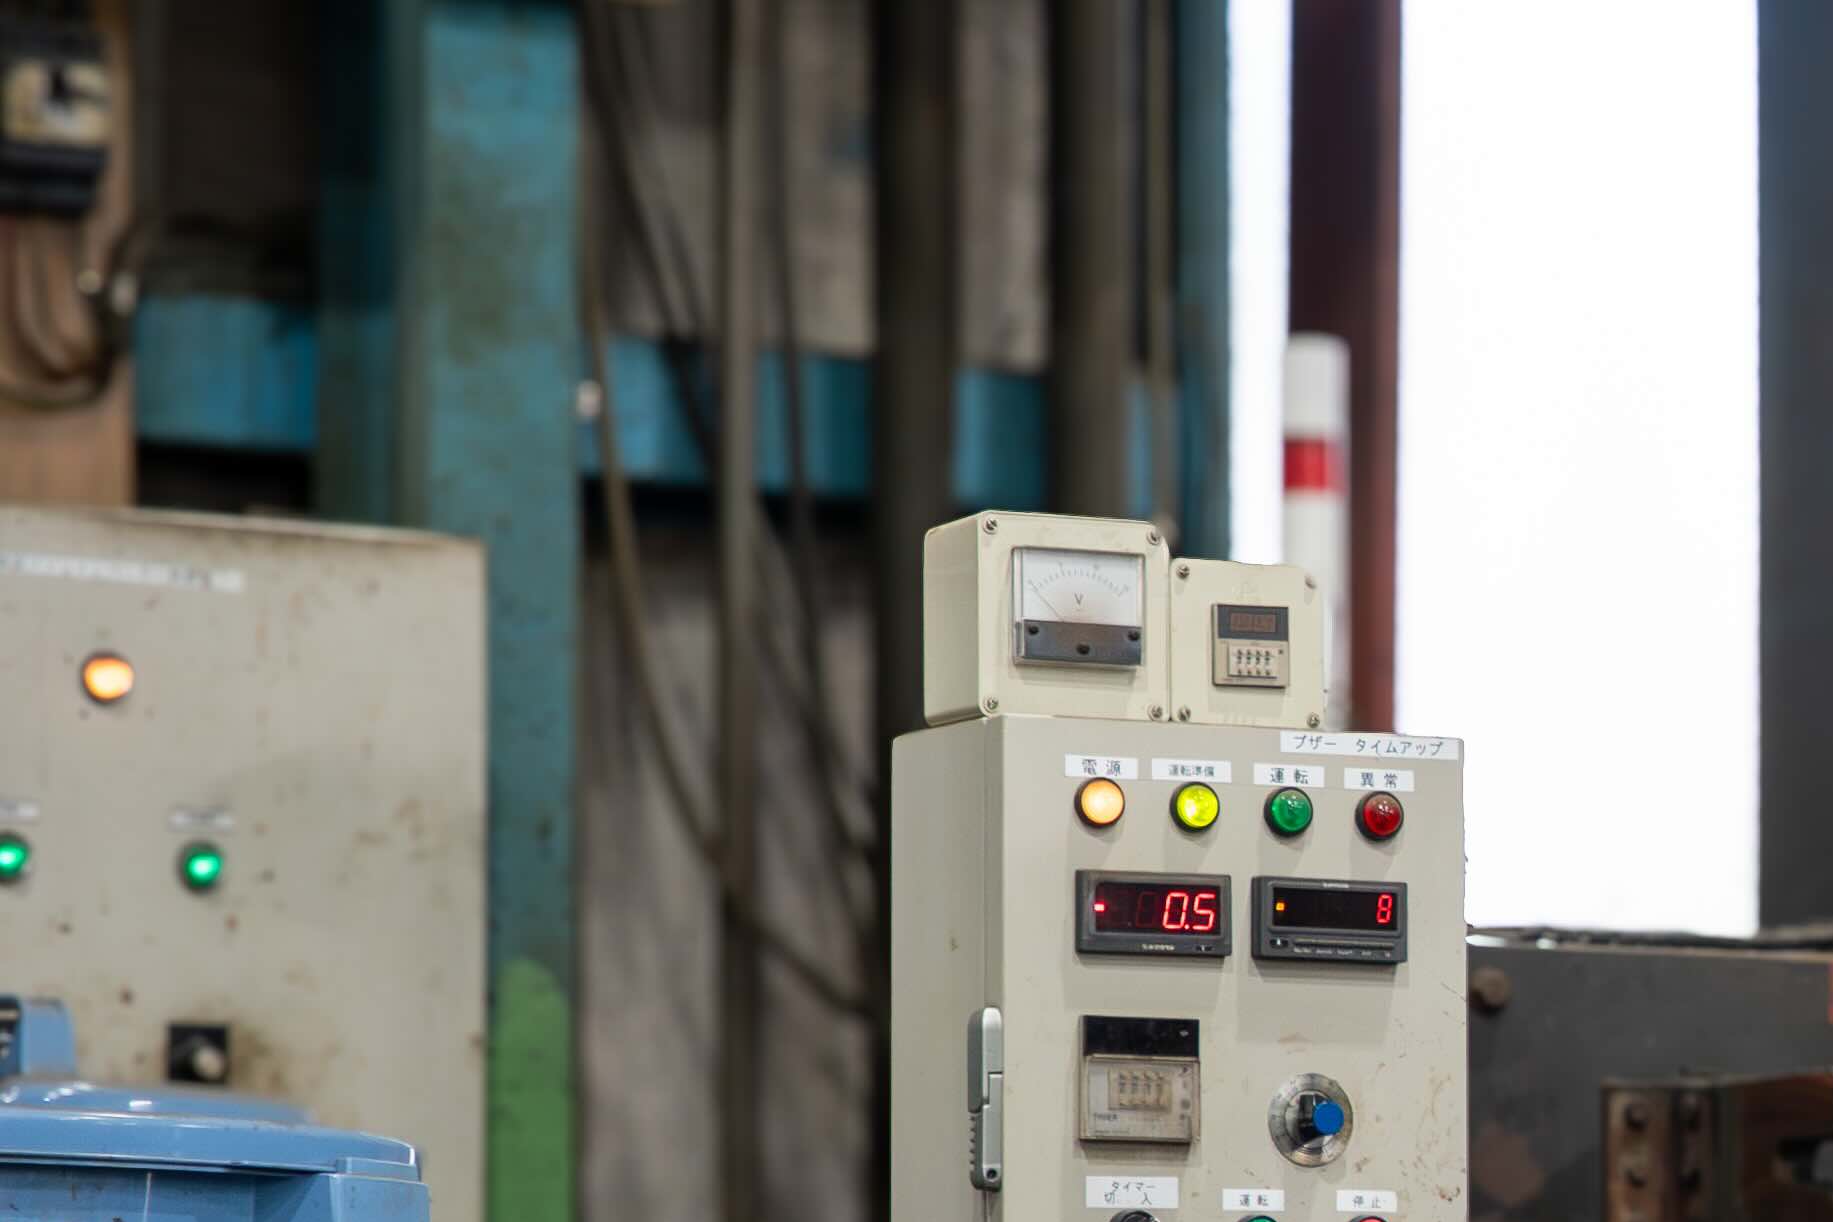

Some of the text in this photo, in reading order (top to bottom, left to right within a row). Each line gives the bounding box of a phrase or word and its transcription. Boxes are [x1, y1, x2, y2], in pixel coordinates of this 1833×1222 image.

[1293, 734, 1443, 757] ブザー タイムアップ
[1081, 759, 1122, 777] 電源
[1269, 767, 1310, 785] 運転
[1360, 772, 1399, 789] 異常
[1162, 892, 1216, 930] 0.5
